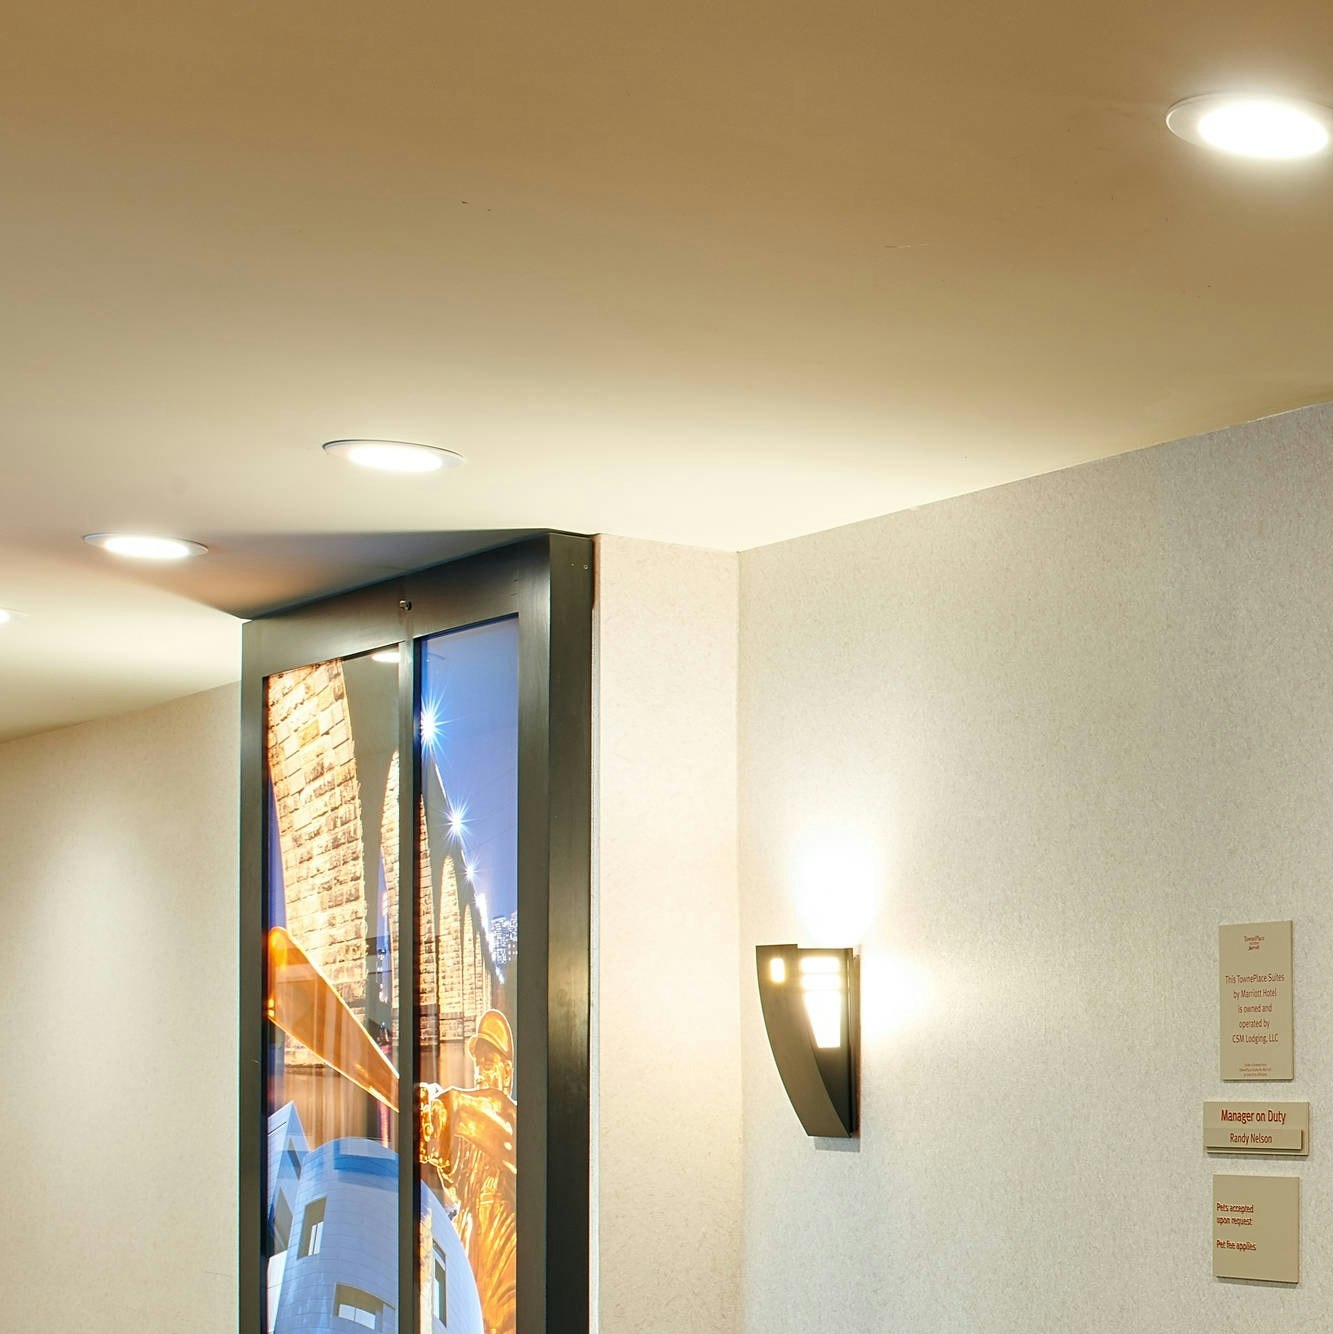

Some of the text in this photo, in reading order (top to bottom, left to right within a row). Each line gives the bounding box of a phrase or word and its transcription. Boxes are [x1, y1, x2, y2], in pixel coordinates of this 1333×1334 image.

[1225, 973, 1285, 984] This TownePlace Suites
[1233, 987, 1277, 1000] by Marriott Hotel
[1238, 1003, 1273, 1013] is owned and
[1239, 1017, 1270, 1029] operated by
[1232, 1034, 1245, 1043] CSM
[1269, 1033, 1279, 1042] LLC
[1220, 1109, 1287, 1125] Manager on Duty
[1230, 1133, 1273, 1144] Randy Nelson
[1216, 1203, 1254, 1214] Pets accepted
[1216, 1217, 1252, 1227] upon request
[1216, 1240, 1257, 1251] Pet fee applies
